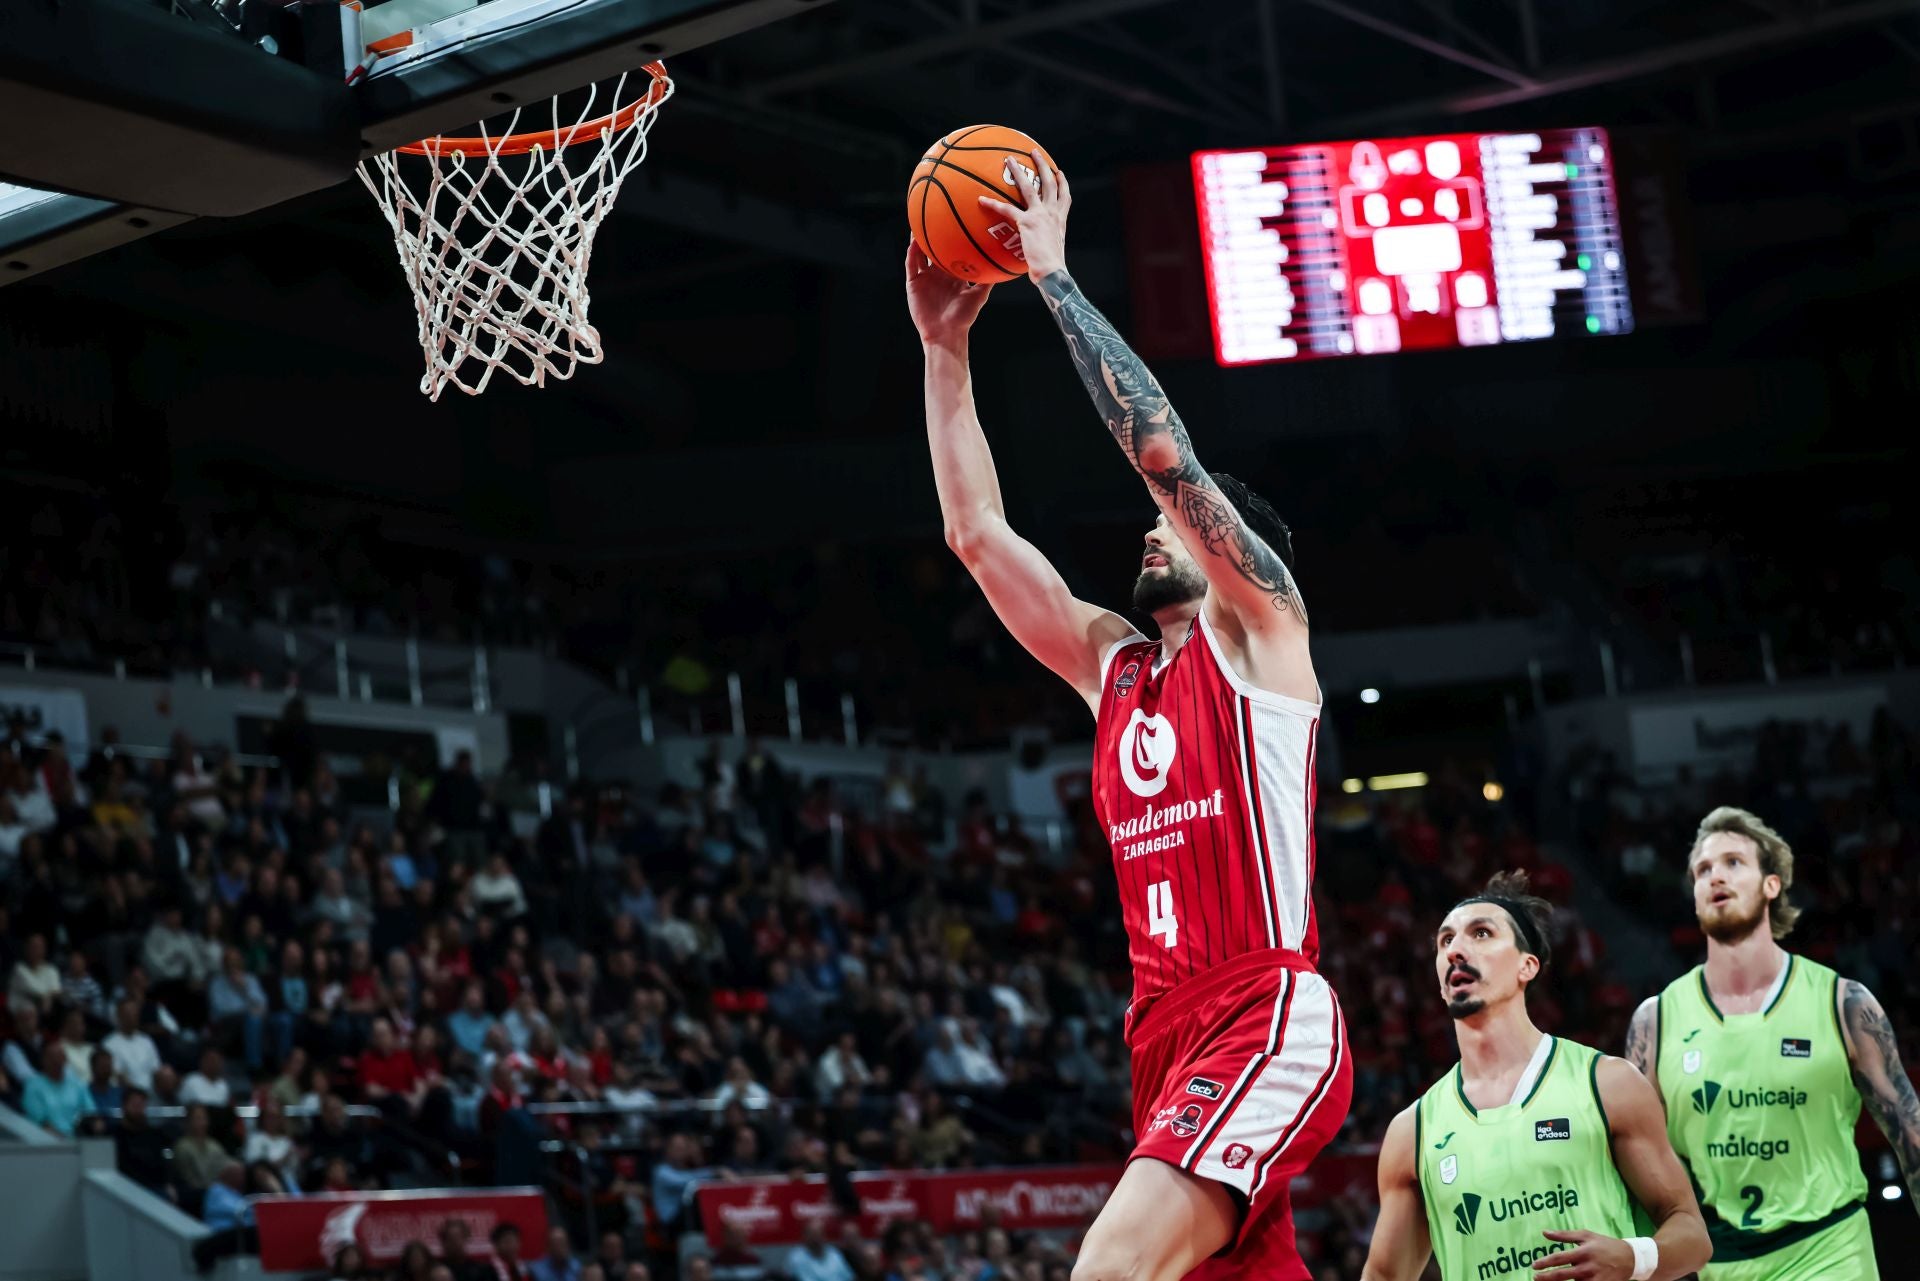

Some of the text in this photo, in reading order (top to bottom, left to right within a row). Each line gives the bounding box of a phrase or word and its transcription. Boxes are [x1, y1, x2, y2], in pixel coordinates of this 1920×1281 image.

[1108, 789, 1225, 845] asademont
[1123, 830, 1185, 861] ZARAGOZA
[1147, 879, 1179, 949] 4
[1190, 1084, 1212, 1095] acb
[1728, 1086, 1808, 1110] Unicaja
[1489, 1184, 1579, 1222] Unicaja
[1740, 1185, 1764, 1227] 2
